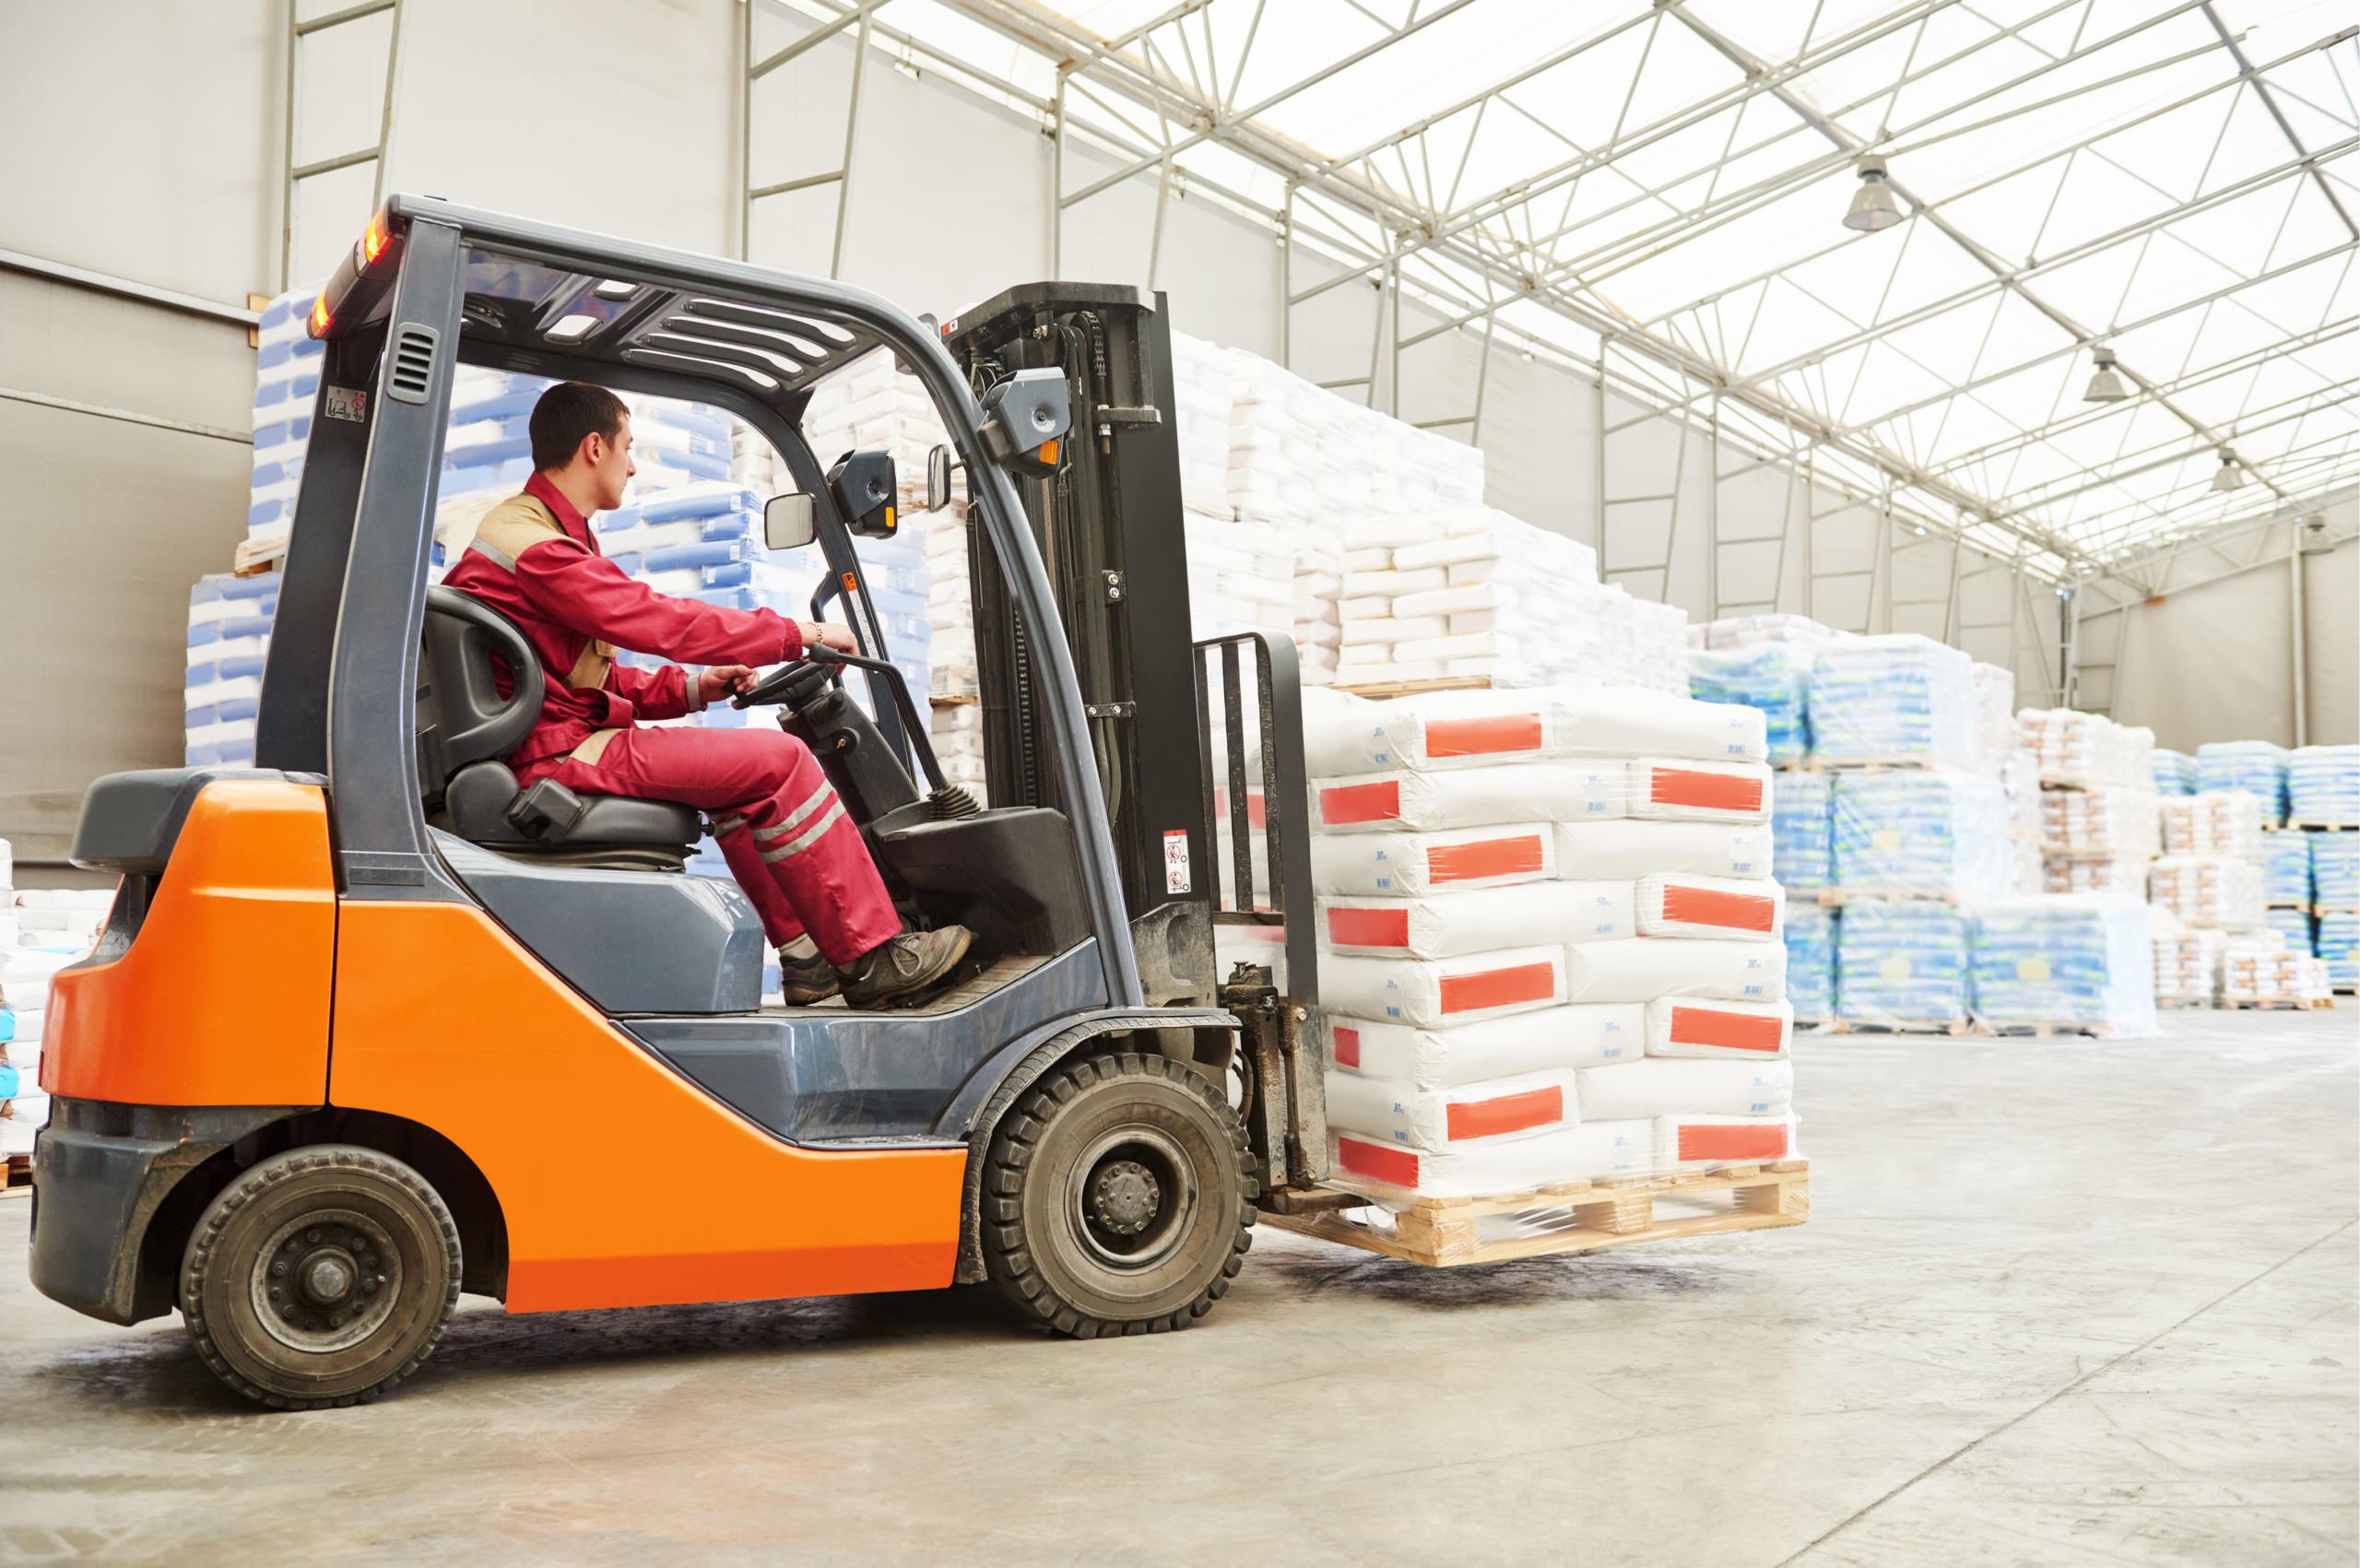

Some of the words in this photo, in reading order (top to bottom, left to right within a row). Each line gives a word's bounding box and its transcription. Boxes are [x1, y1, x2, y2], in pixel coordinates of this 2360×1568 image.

[1728, 719, 1737, 727] 30
[1587, 775, 1597, 784] 30
[1733, 837, 1742, 846] 30
[1376, 851, 1384, 860] 30
[1597, 897, 1606, 907] 30
[1747, 960, 1756, 968] 30
[1386, 979, 1394, 988] 30
[1605, 1021, 1614, 1032] 30
[1752, 1078, 1762, 1087] 30
[1393, 1102, 1401, 1113] 30
[1614, 1137, 1623, 1147] 30
